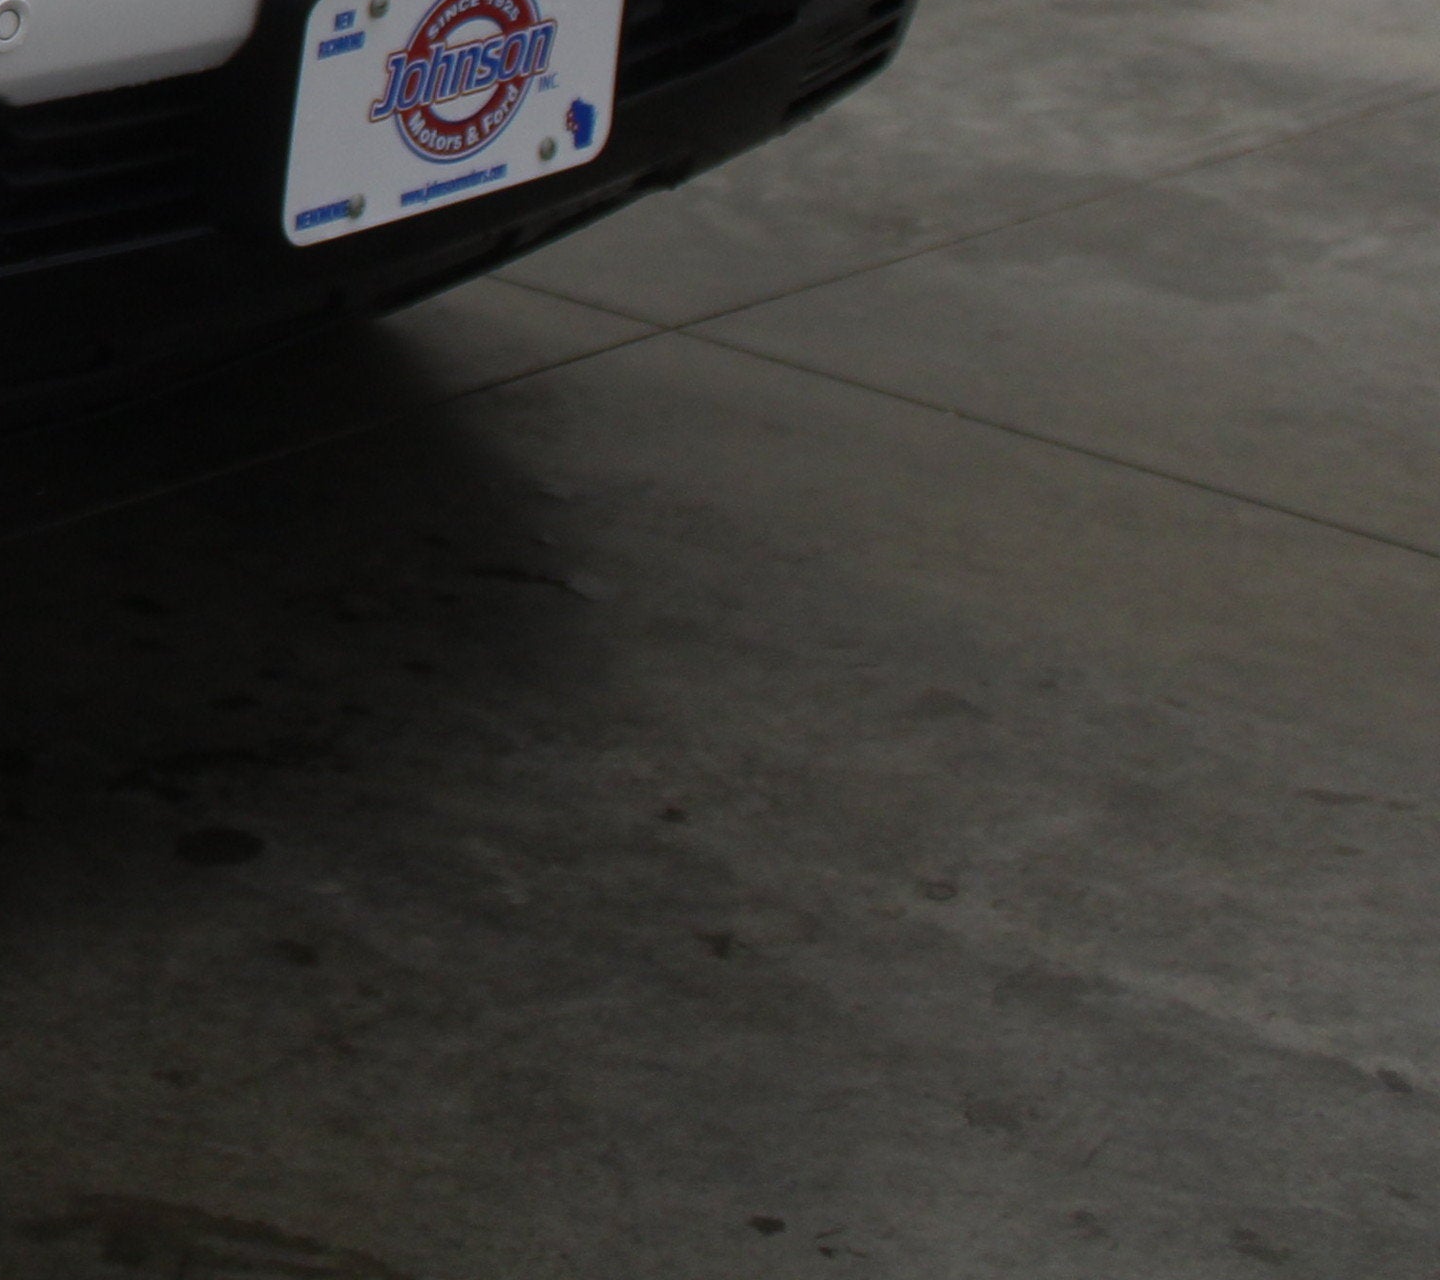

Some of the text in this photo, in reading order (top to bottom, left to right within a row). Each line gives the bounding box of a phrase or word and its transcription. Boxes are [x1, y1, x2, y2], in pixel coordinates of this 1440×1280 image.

[370, 20, 557, 121] Johnson
[408, 83, 520, 150] Motors & Ford
